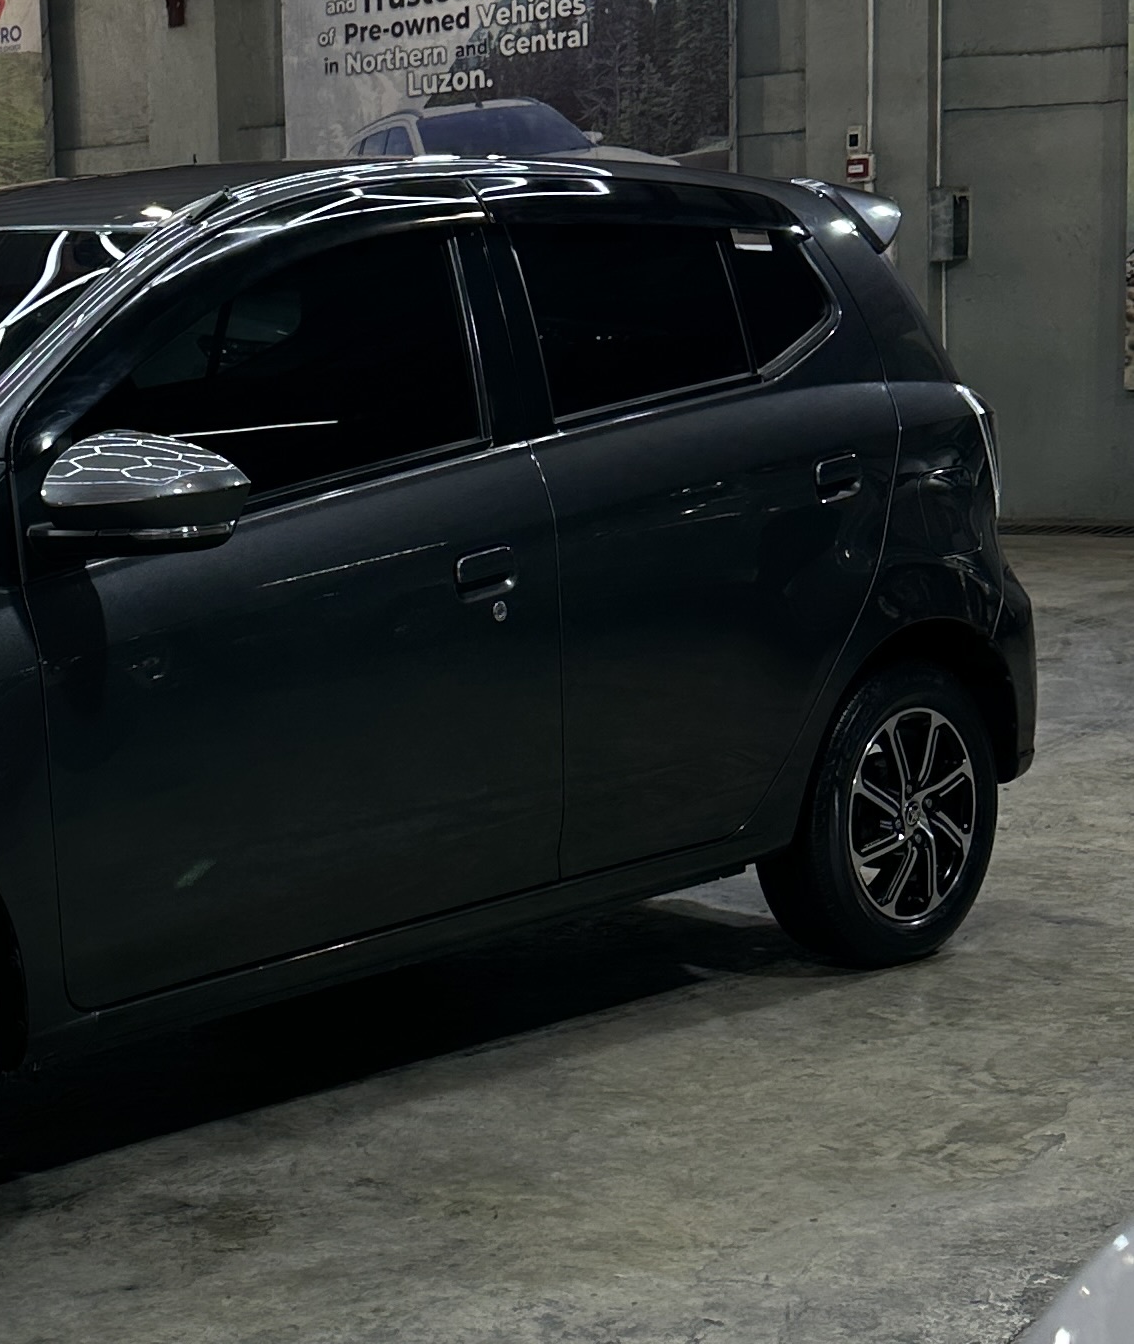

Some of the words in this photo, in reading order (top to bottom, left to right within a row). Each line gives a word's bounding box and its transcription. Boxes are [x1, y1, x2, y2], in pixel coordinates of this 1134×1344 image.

[318, 28, 336, 48] of
[344, 7, 471, 45] Pre-owned
[324, 57, 339, 75] in
[345, 41, 447, 76] Northern
[455, 40, 488, 60] and
[499, 22, 589, 58] Central
[406, 66, 493, 97] Luzon.
